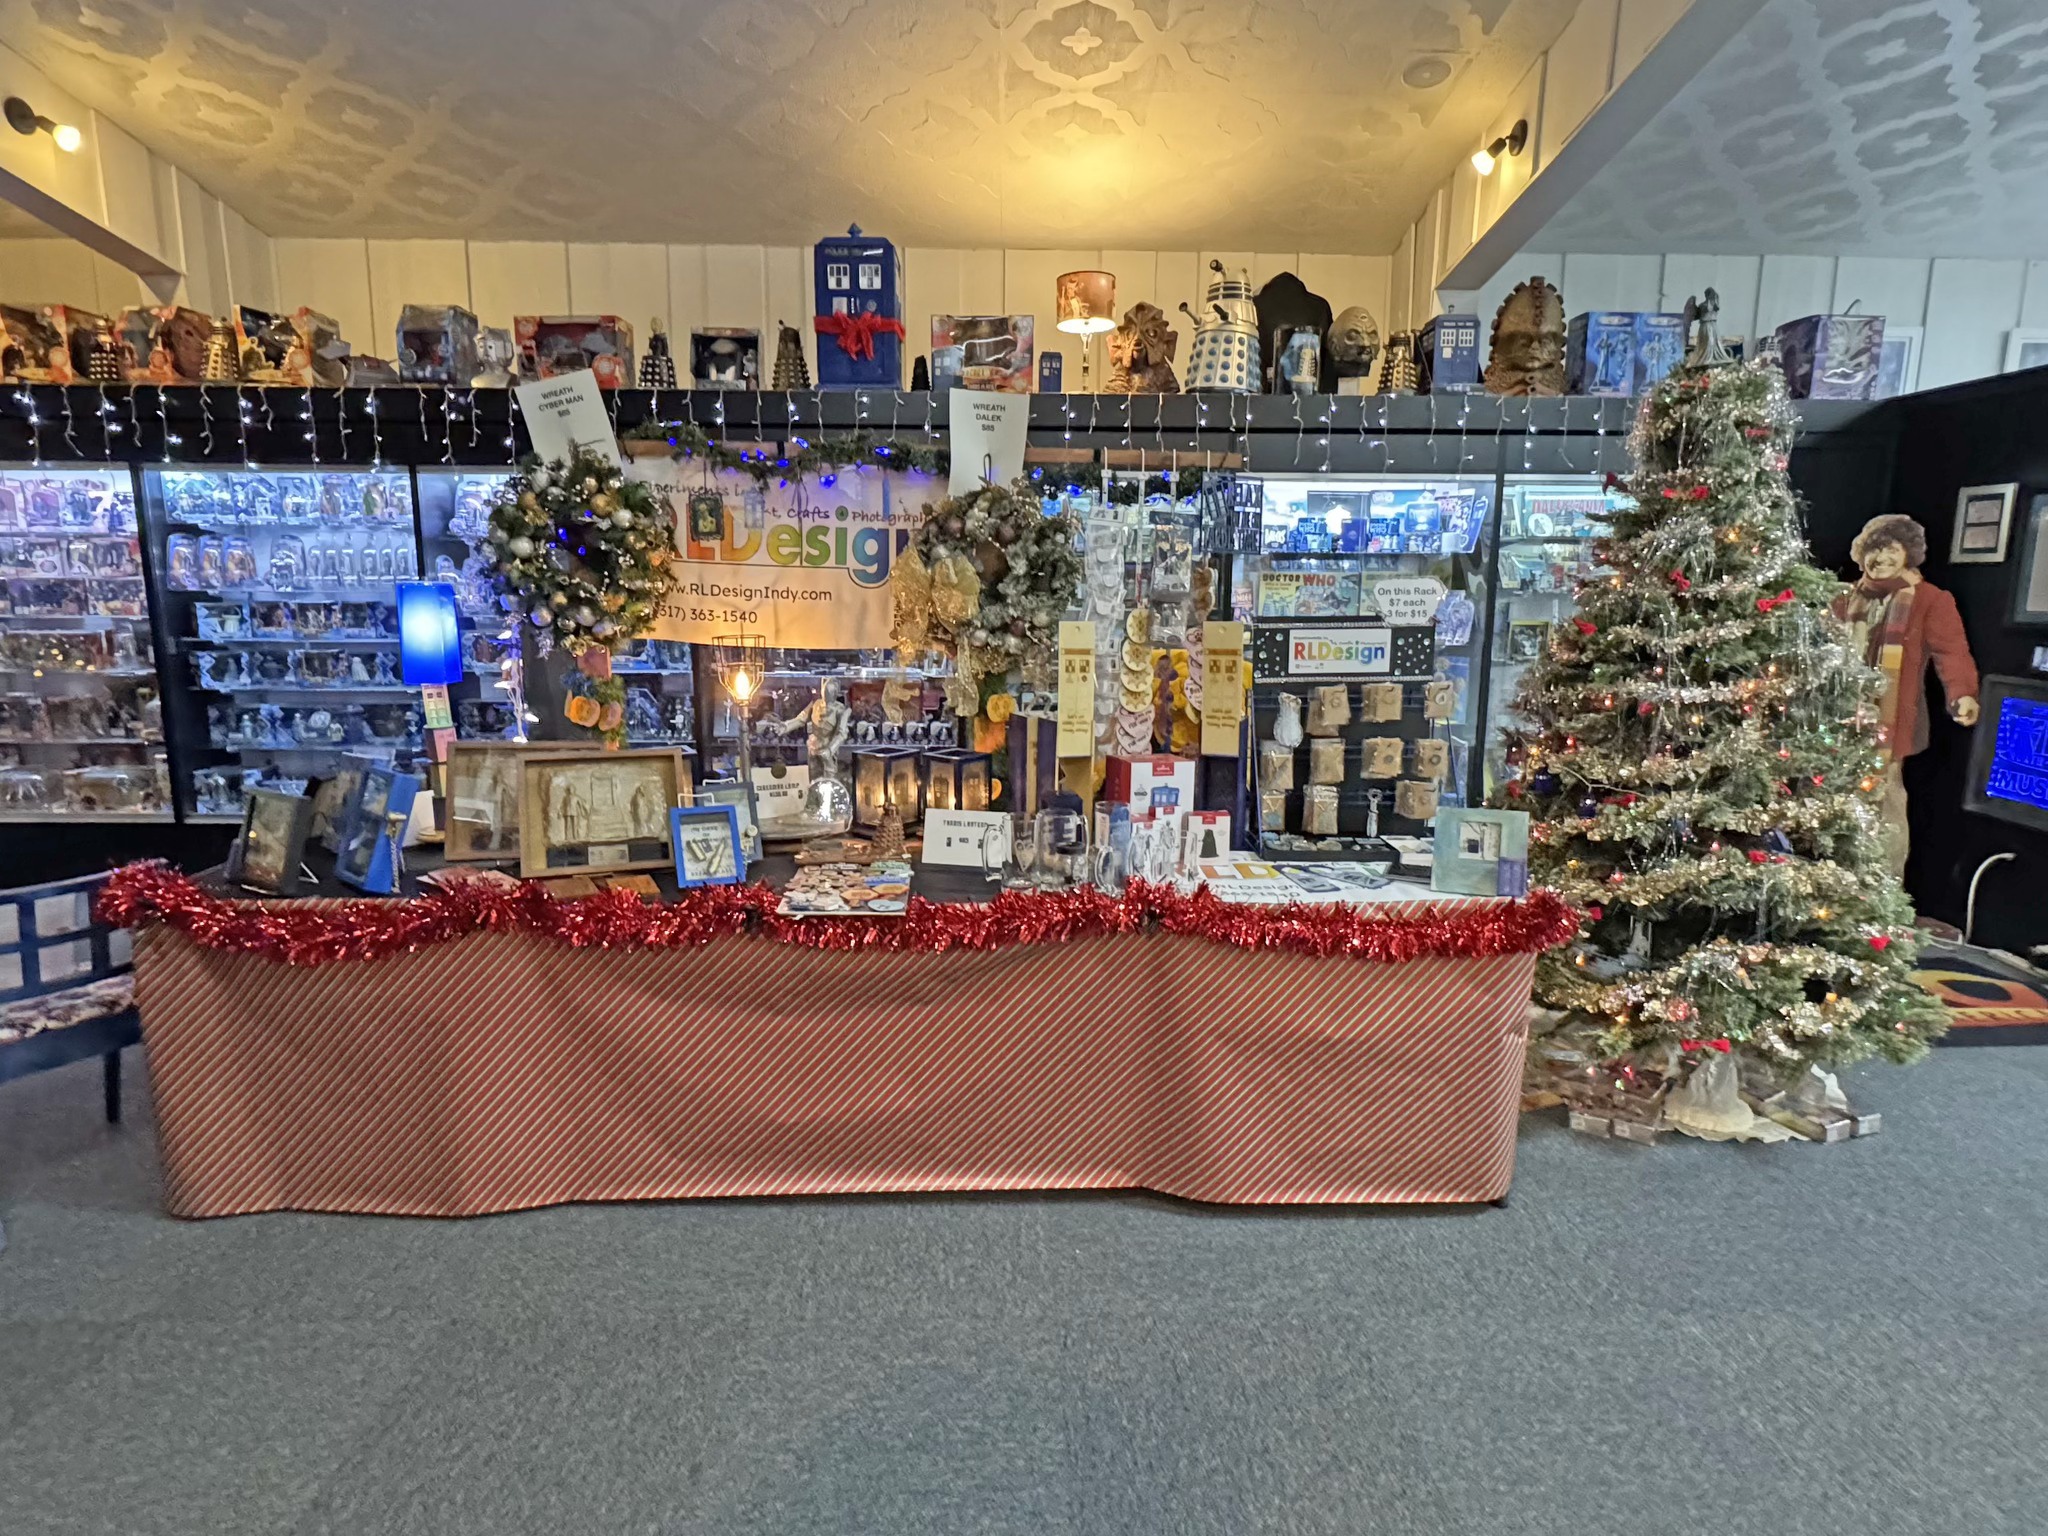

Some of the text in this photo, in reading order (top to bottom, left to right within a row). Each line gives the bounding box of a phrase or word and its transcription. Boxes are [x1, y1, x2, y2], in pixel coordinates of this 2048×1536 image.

[541, 386, 573, 400] WREATH
[565, 394, 584, 405] MAN
[973, 403, 1006, 412] WREATH
[975, 413, 1002, 422] DALEK
[787, 505, 830, 523] Crafts
[1262, 574, 1300, 583] DOCTOR
[1302, 574, 1336, 587] WHO
[1377, 586, 1437, 596] On this Rack
[1389, 598, 1426, 607] $7 each
[689, 609, 758, 624] 363-1540
[1387, 609, 1428, 618] 3 for $15
[1294, 641, 1385, 665] RLDesign
[1996, 768, 2048, 800] MUS
